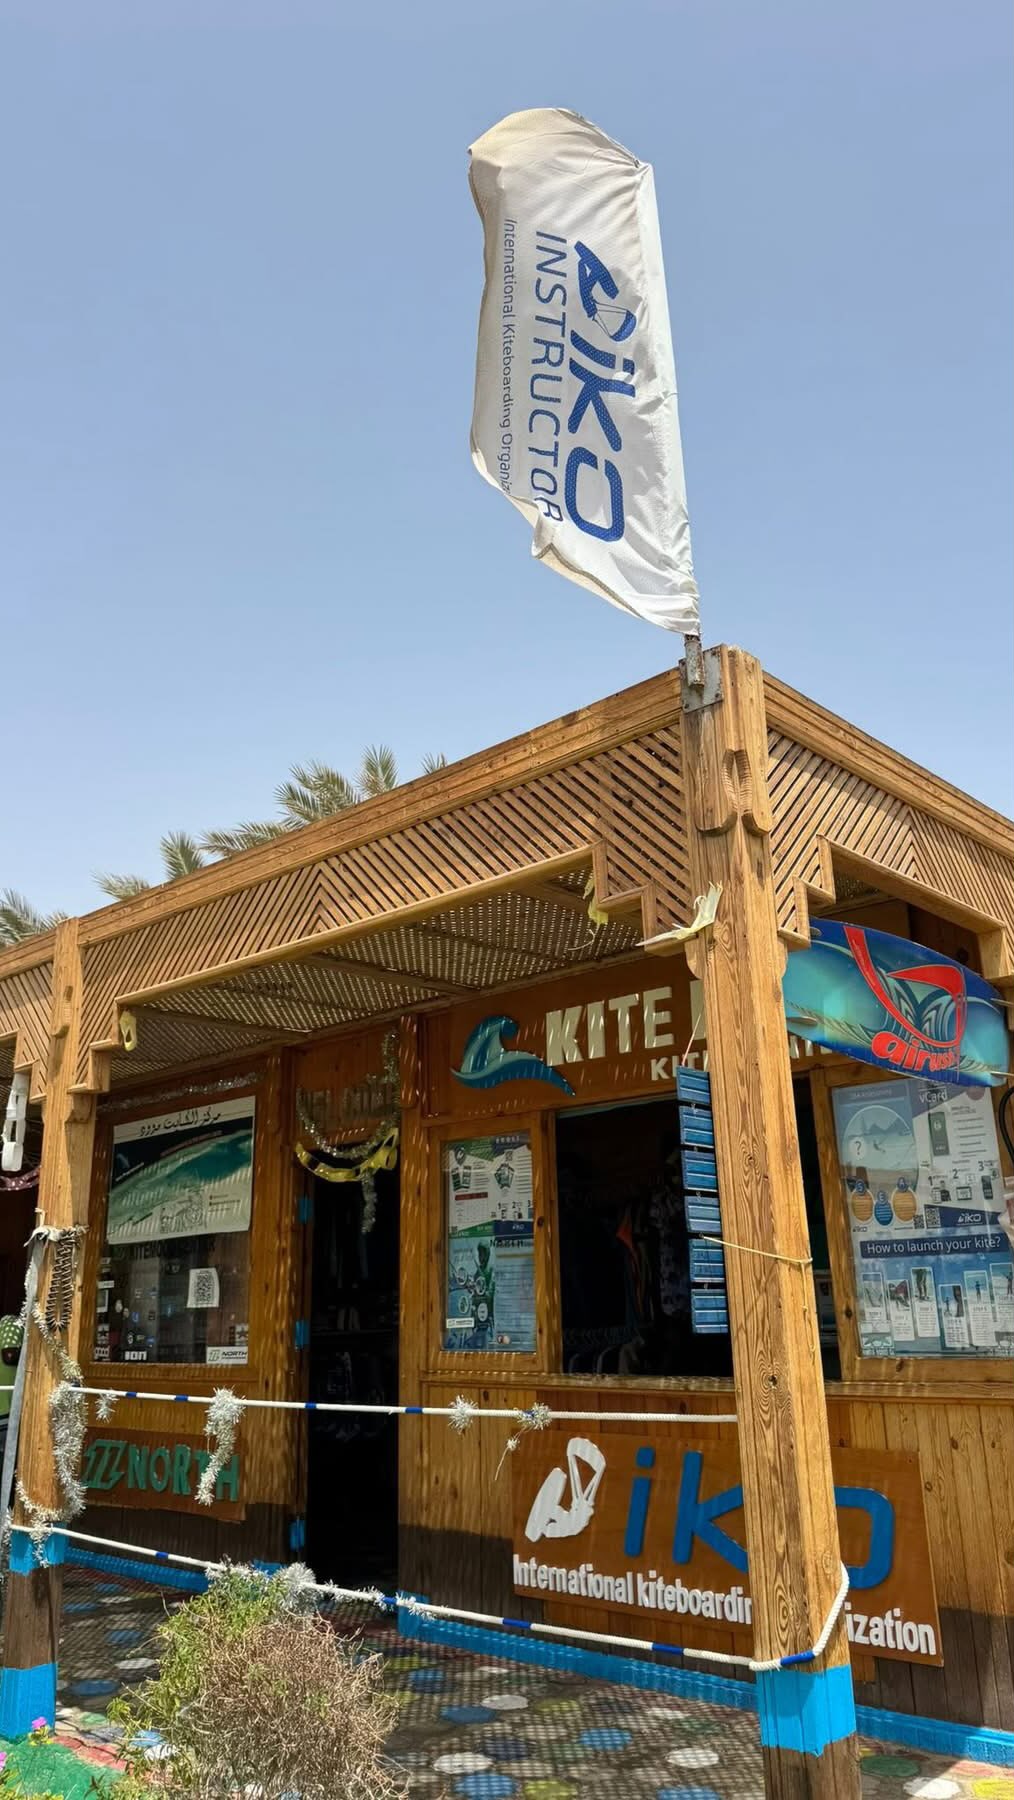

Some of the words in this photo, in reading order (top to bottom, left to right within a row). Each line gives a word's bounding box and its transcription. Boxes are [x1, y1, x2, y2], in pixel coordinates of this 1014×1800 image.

[502, 218, 518, 318] International
[499, 323, 516, 429] Kiteboarding
[527, 231, 567, 522] INSTRUCTOR
[545, 986, 674, 1066] KITE
[918, 1088, 948, 1103] vCard
[867, 1243, 891, 1254] How
[893, 1242, 904, 1252] to
[907, 1239, 943, 1252] launch
[946, 1240, 971, 1253] your
[974, 1236, 1001, 1248] kite?
[513, 1553, 634, 1604] International
